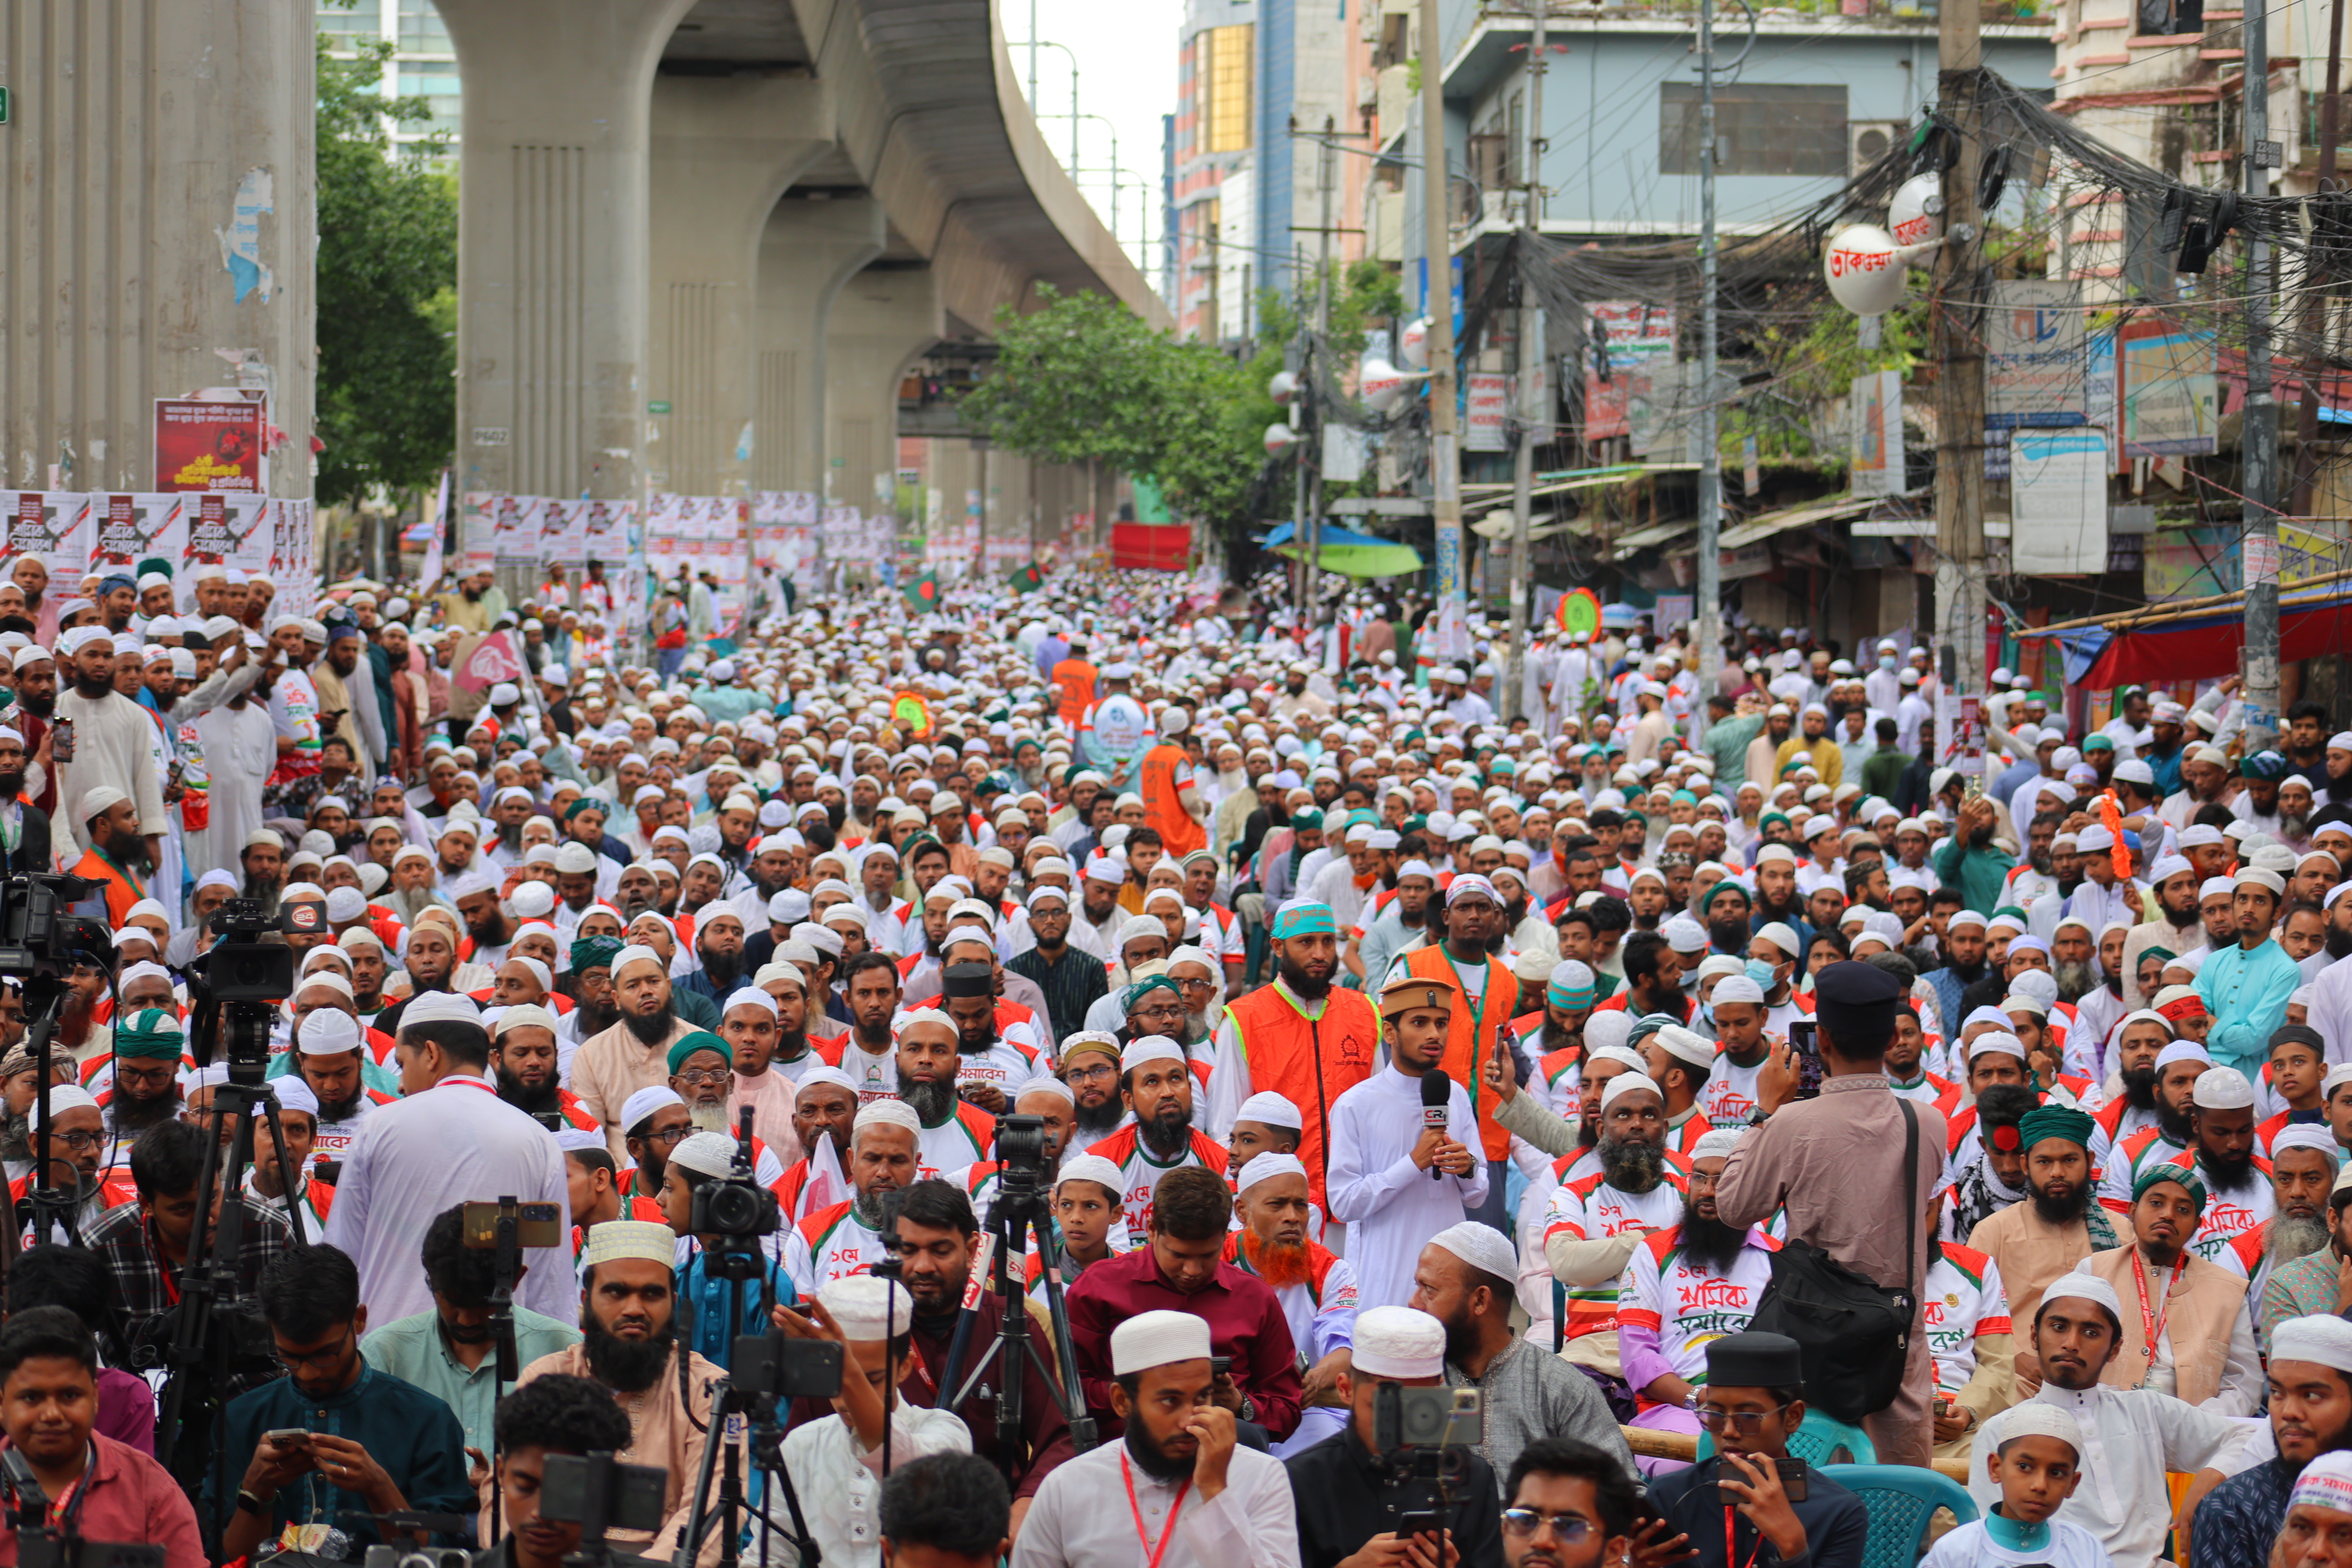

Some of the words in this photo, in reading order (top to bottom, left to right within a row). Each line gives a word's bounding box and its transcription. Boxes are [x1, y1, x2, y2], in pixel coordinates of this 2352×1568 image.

[1831, 248, 1892, 278] তাকওয়া
[956, 1069, 1006, 1081] সমাবেশ
[2199, 1203, 2254, 1242] শ্রমিক
[1677, 1278, 1749, 1316] শ্রমিক
[1672, 1309, 1755, 1335] সমাবে
